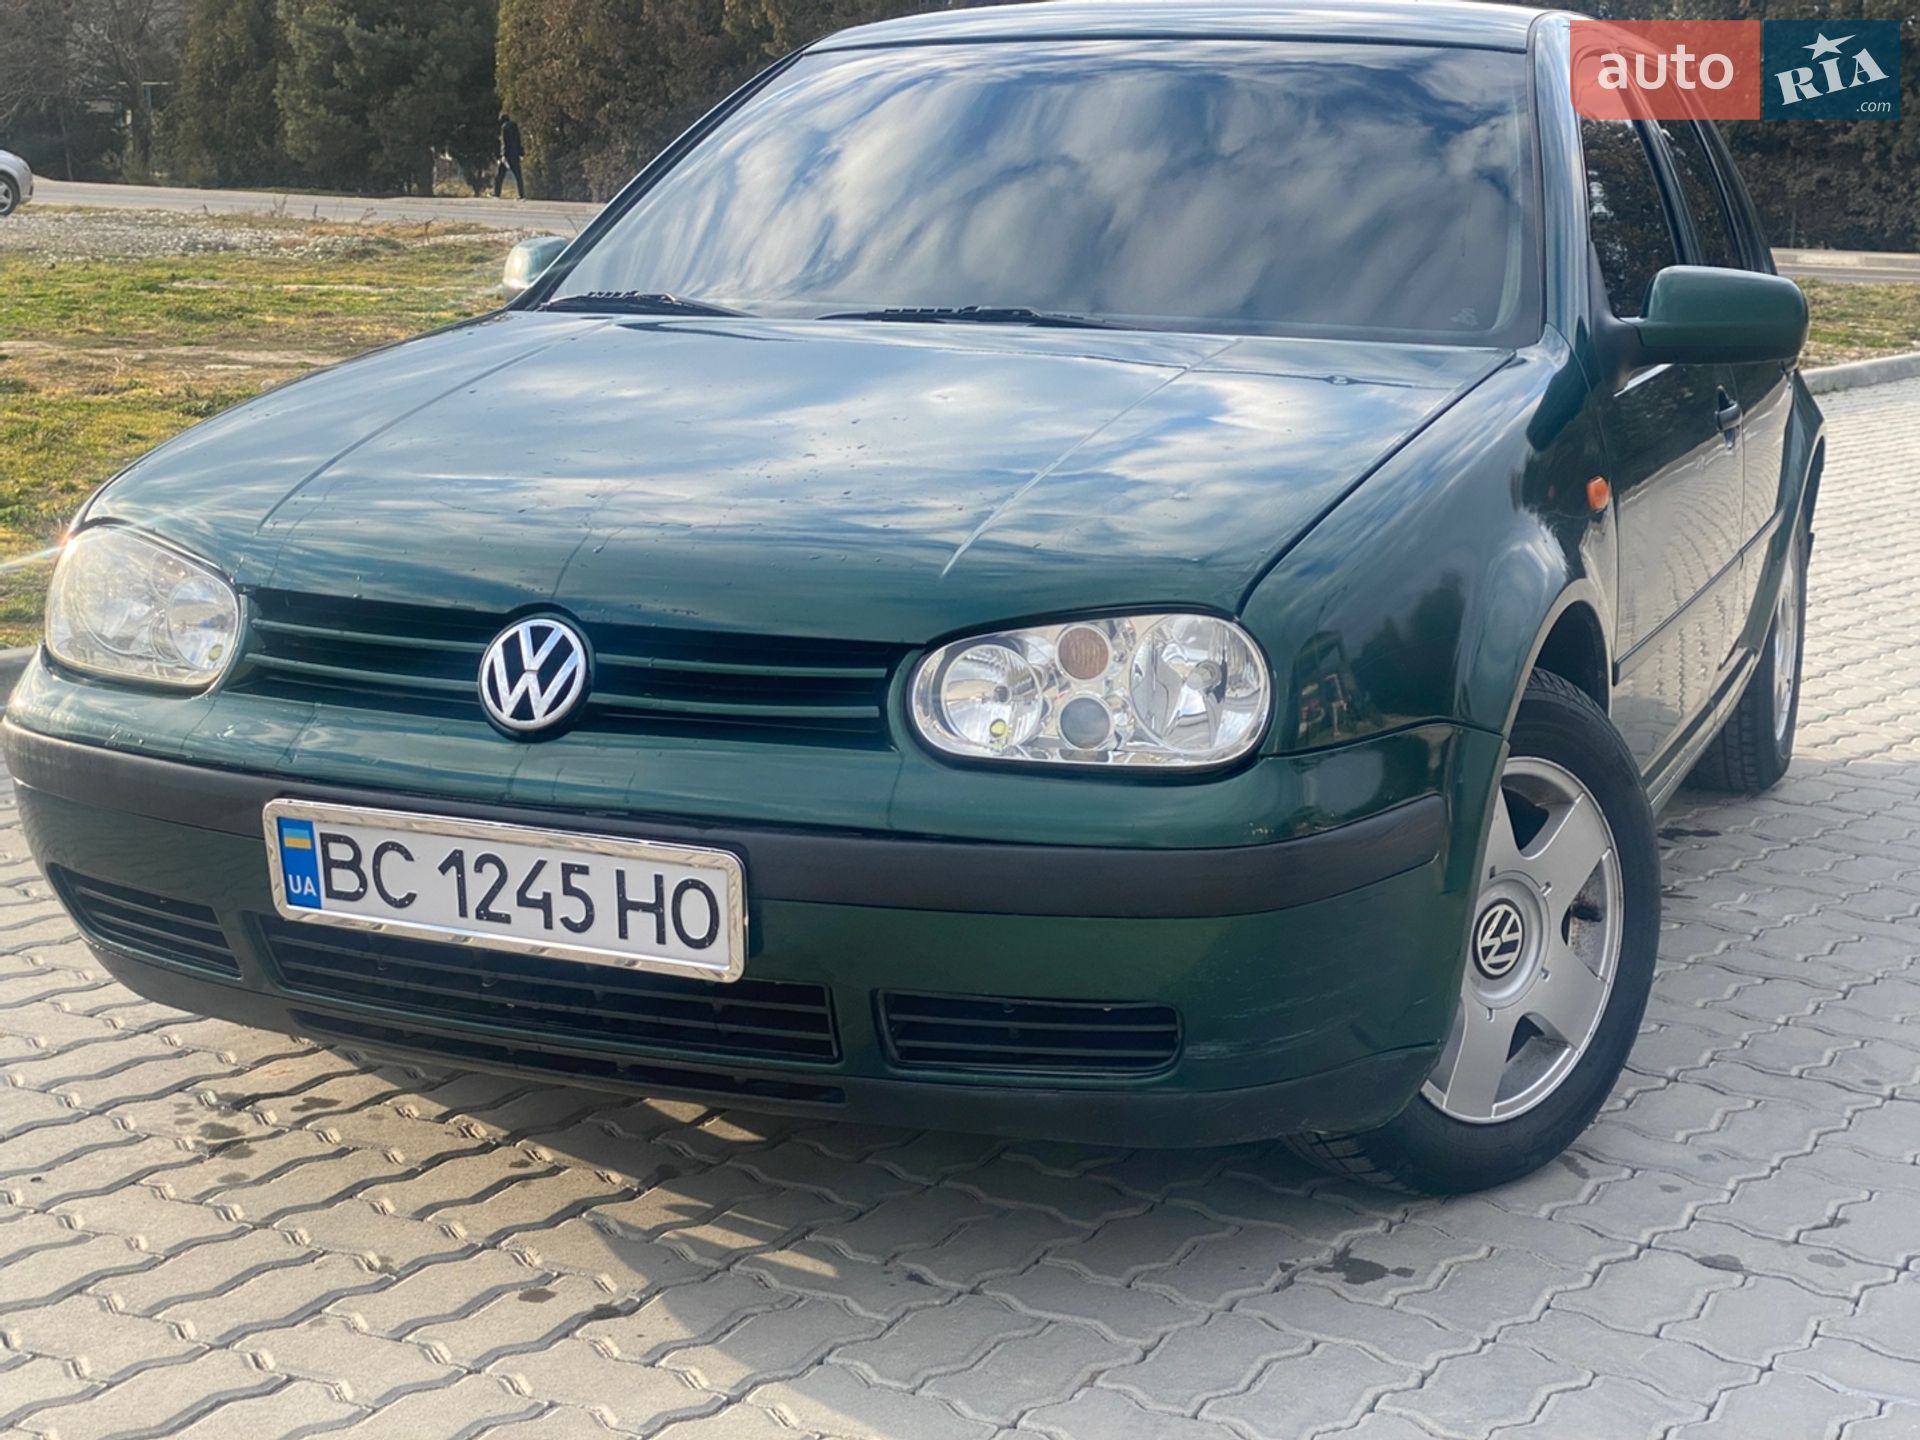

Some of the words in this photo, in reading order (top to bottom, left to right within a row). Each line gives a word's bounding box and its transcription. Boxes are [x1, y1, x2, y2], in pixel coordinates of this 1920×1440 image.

[288, 874, 317, 898] UA
[319, 832, 417, 909] BC
[437, 848, 595, 933] 1245
[615, 868, 720, 950] HO
